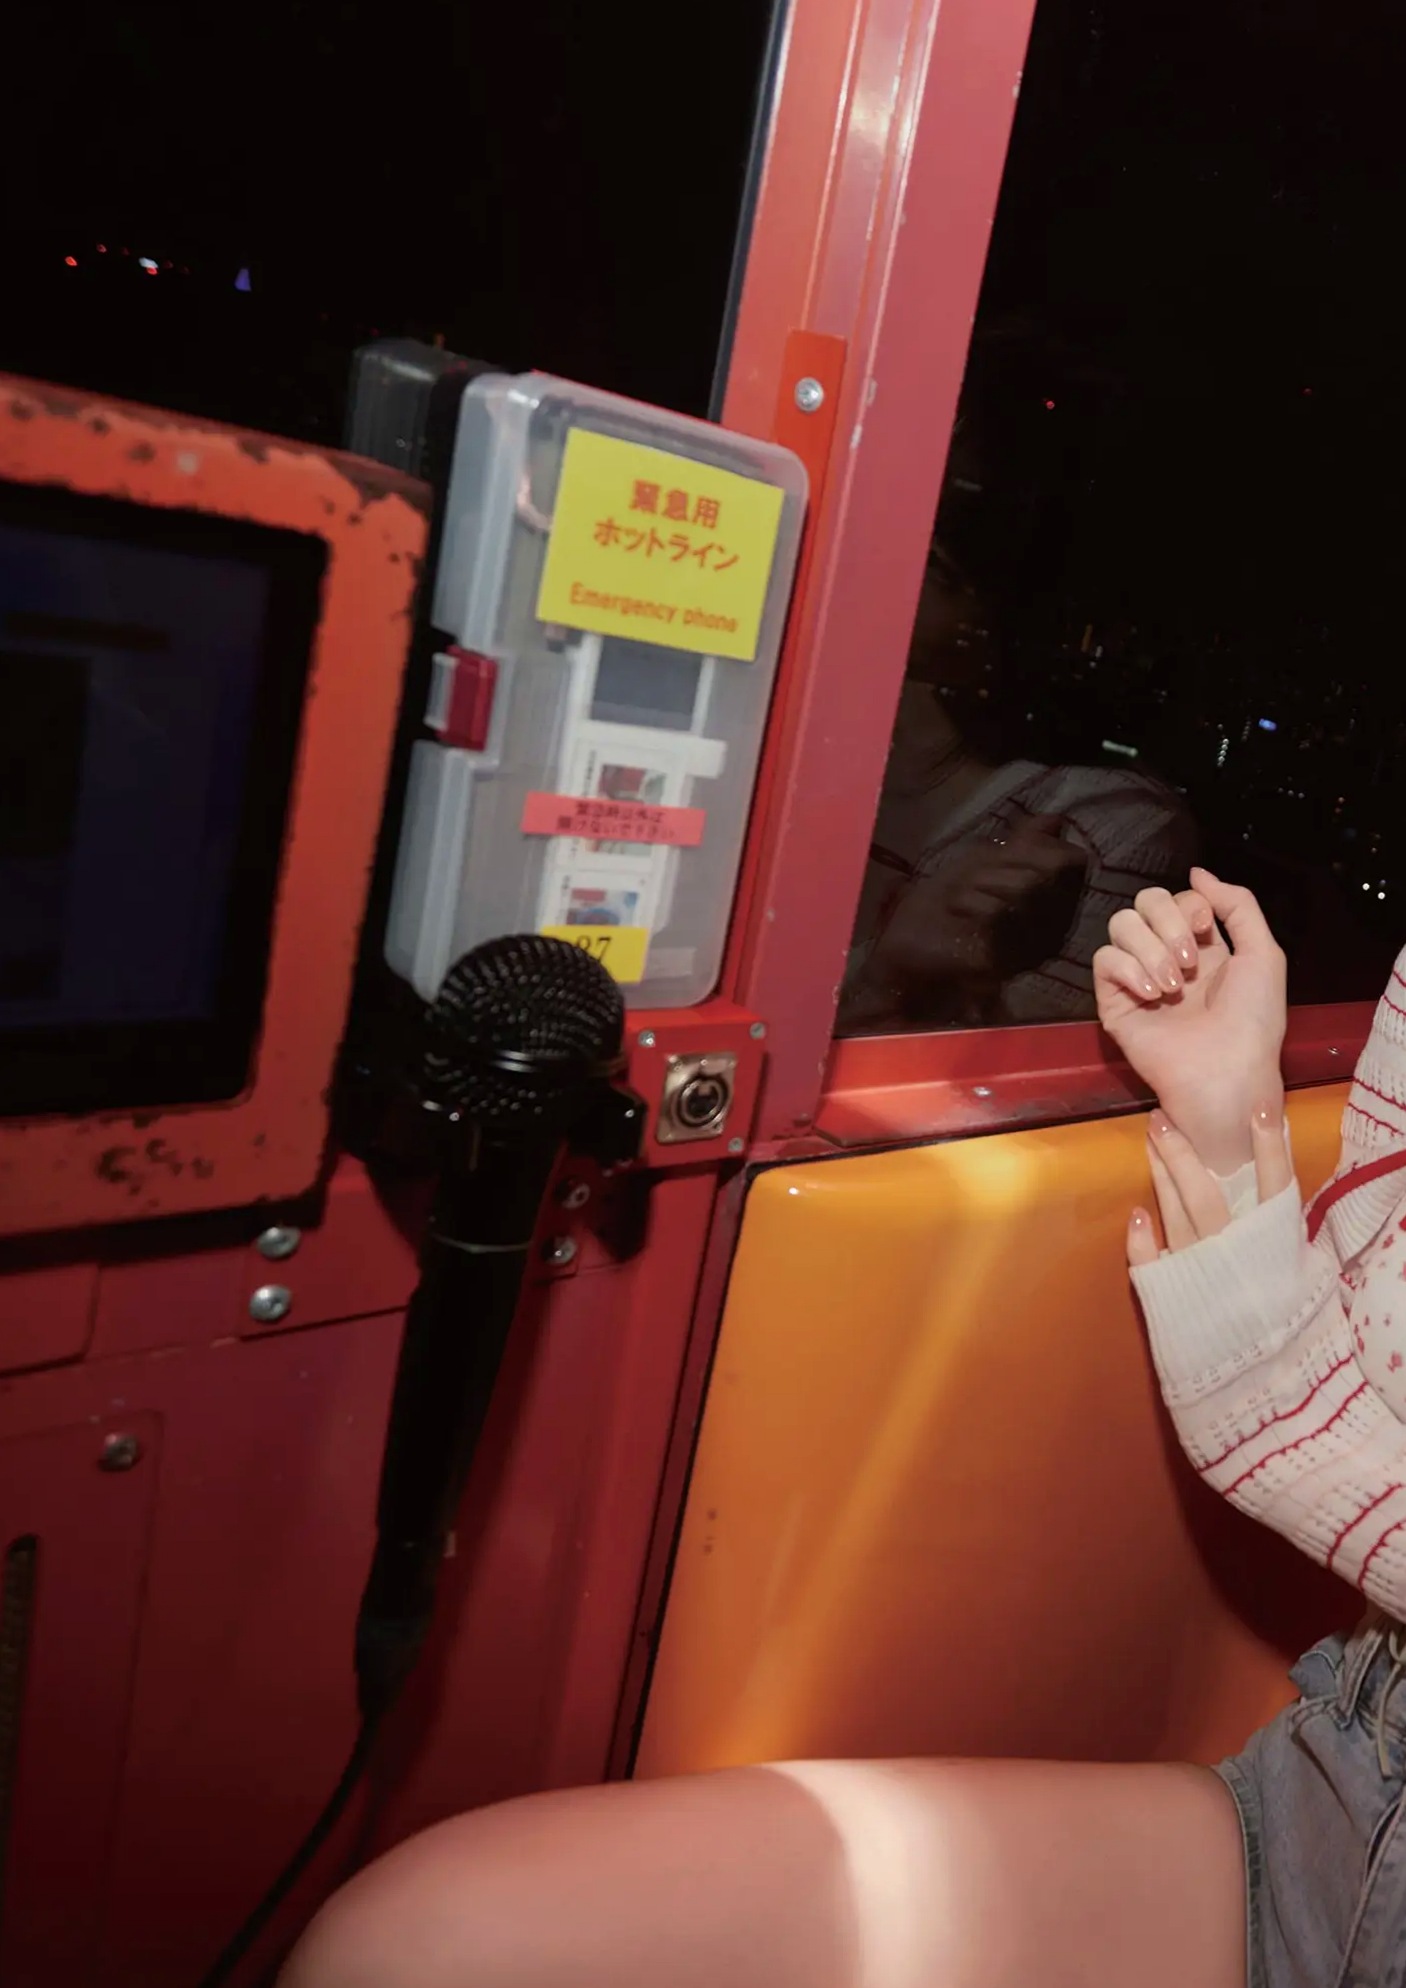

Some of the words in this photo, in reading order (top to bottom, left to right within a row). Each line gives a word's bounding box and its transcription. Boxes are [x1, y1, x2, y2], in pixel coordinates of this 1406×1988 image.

[629, 479, 720, 529] 緊急用
[594, 517, 740, 571] ホットライン
[570, 581, 678, 623] Emergency
[683, 608, 738, 633] phone
